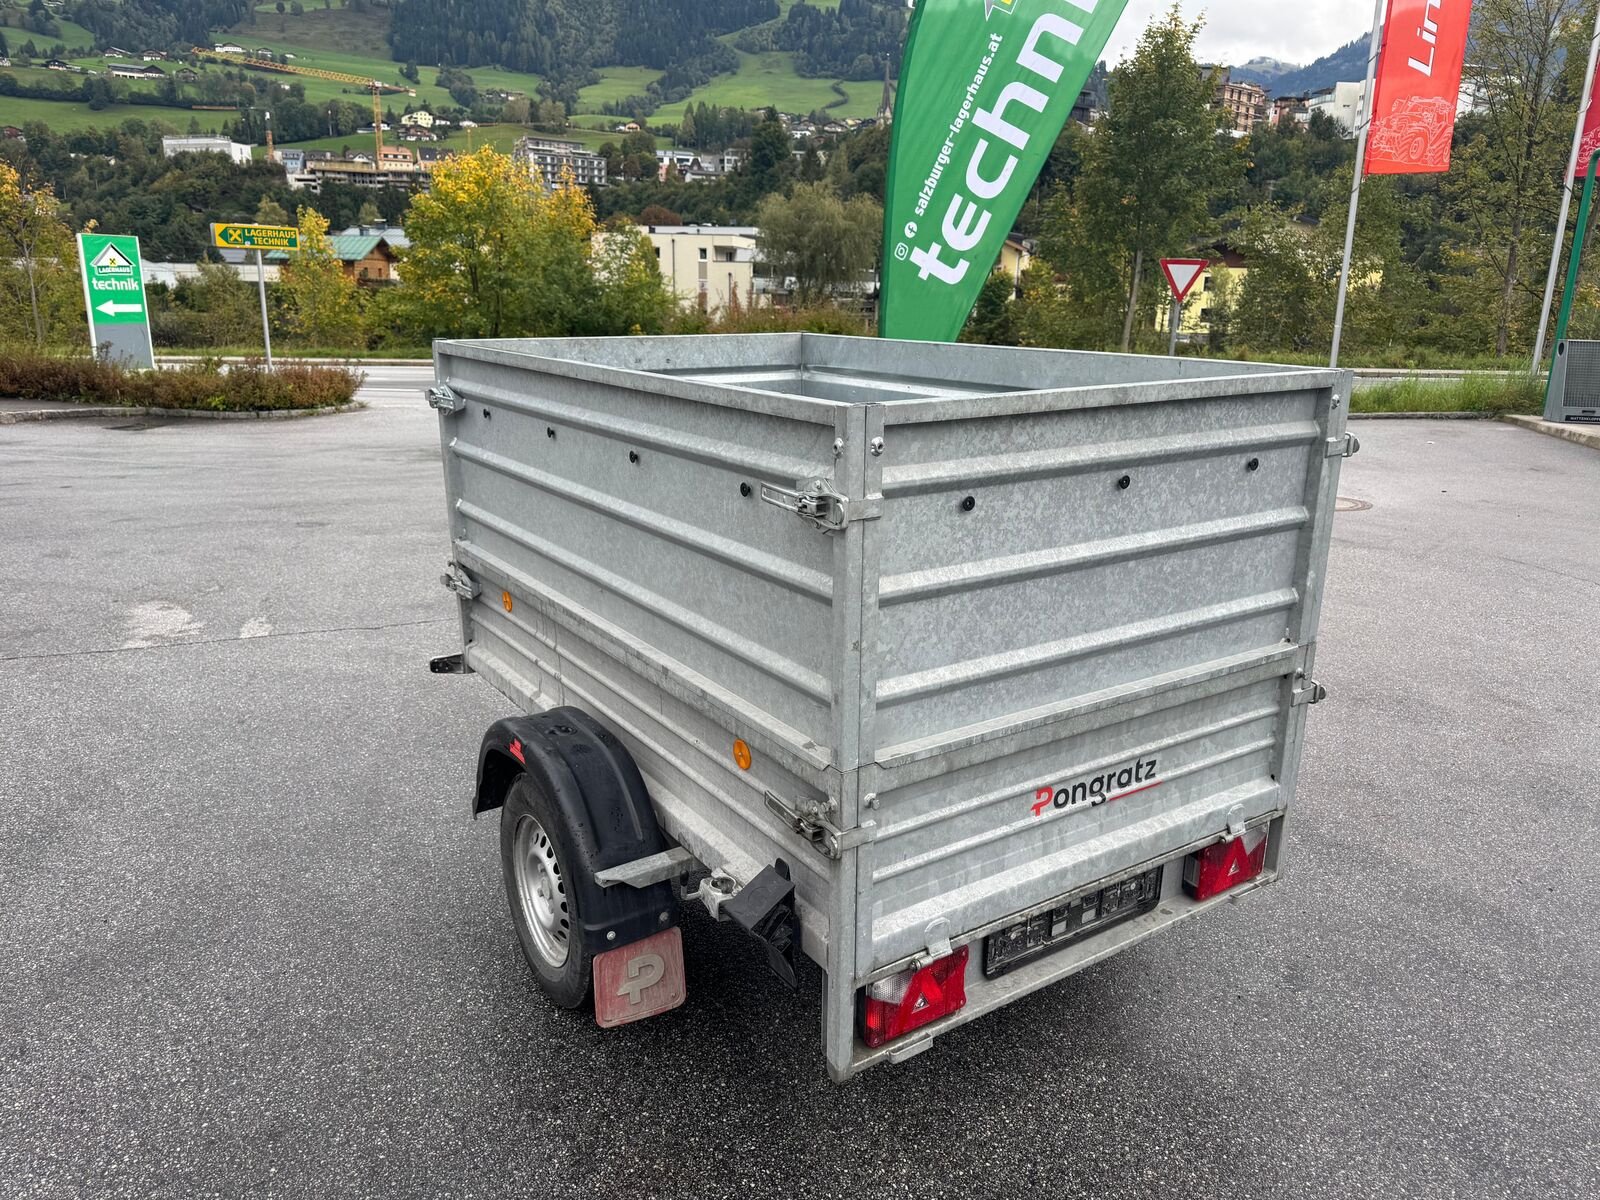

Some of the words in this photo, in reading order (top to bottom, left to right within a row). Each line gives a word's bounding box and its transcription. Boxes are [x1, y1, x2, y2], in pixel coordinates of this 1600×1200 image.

[914, 32, 1003, 217] salzburger-lagerhaus.at
[244, 229, 296, 239] LAGERHAUS
[253, 237, 289, 246] TECHNIK
[91, 277, 139, 291] technik
[1030, 758, 1157, 817] Pongratz
